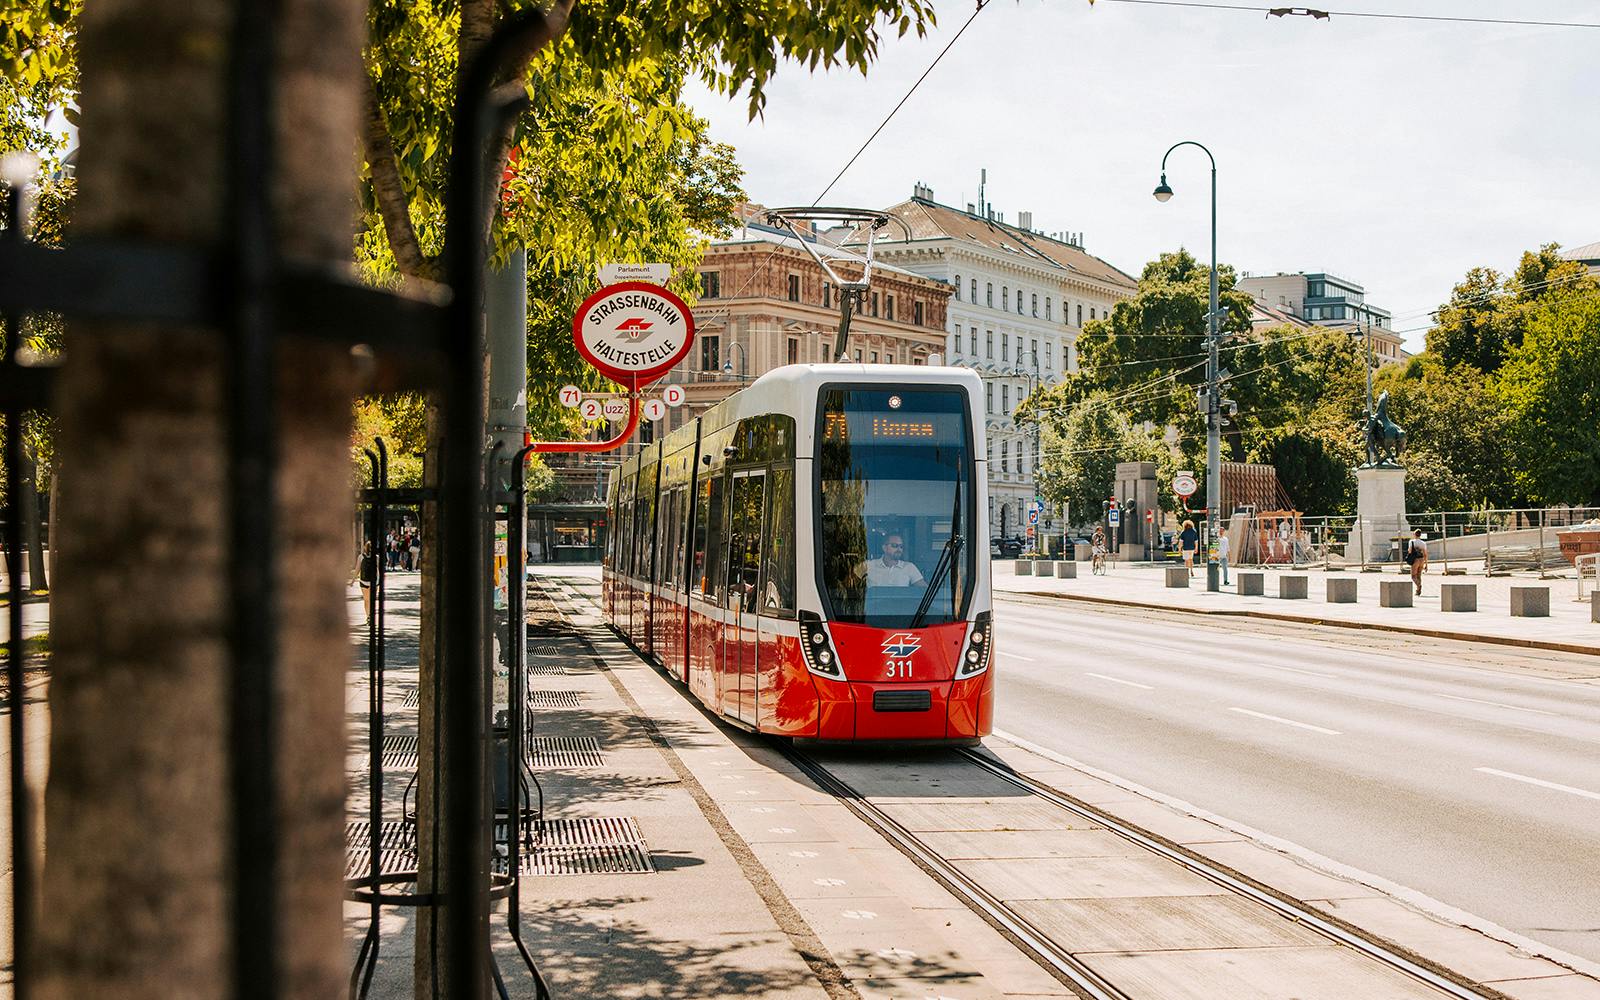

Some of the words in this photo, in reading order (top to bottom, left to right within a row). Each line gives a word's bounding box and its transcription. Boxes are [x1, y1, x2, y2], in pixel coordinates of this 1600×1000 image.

[590, 295, 680, 326] STRASSENBAHN
[593, 339, 676, 366] HALTESTELLE
[563, 390, 579, 402] 71
[669, 391, 679, 401] D
[586, 404, 595, 416] 2
[652, 404, 658, 415] 1
[825, 414, 846, 439] 71
[886, 660, 913, 678] 311
